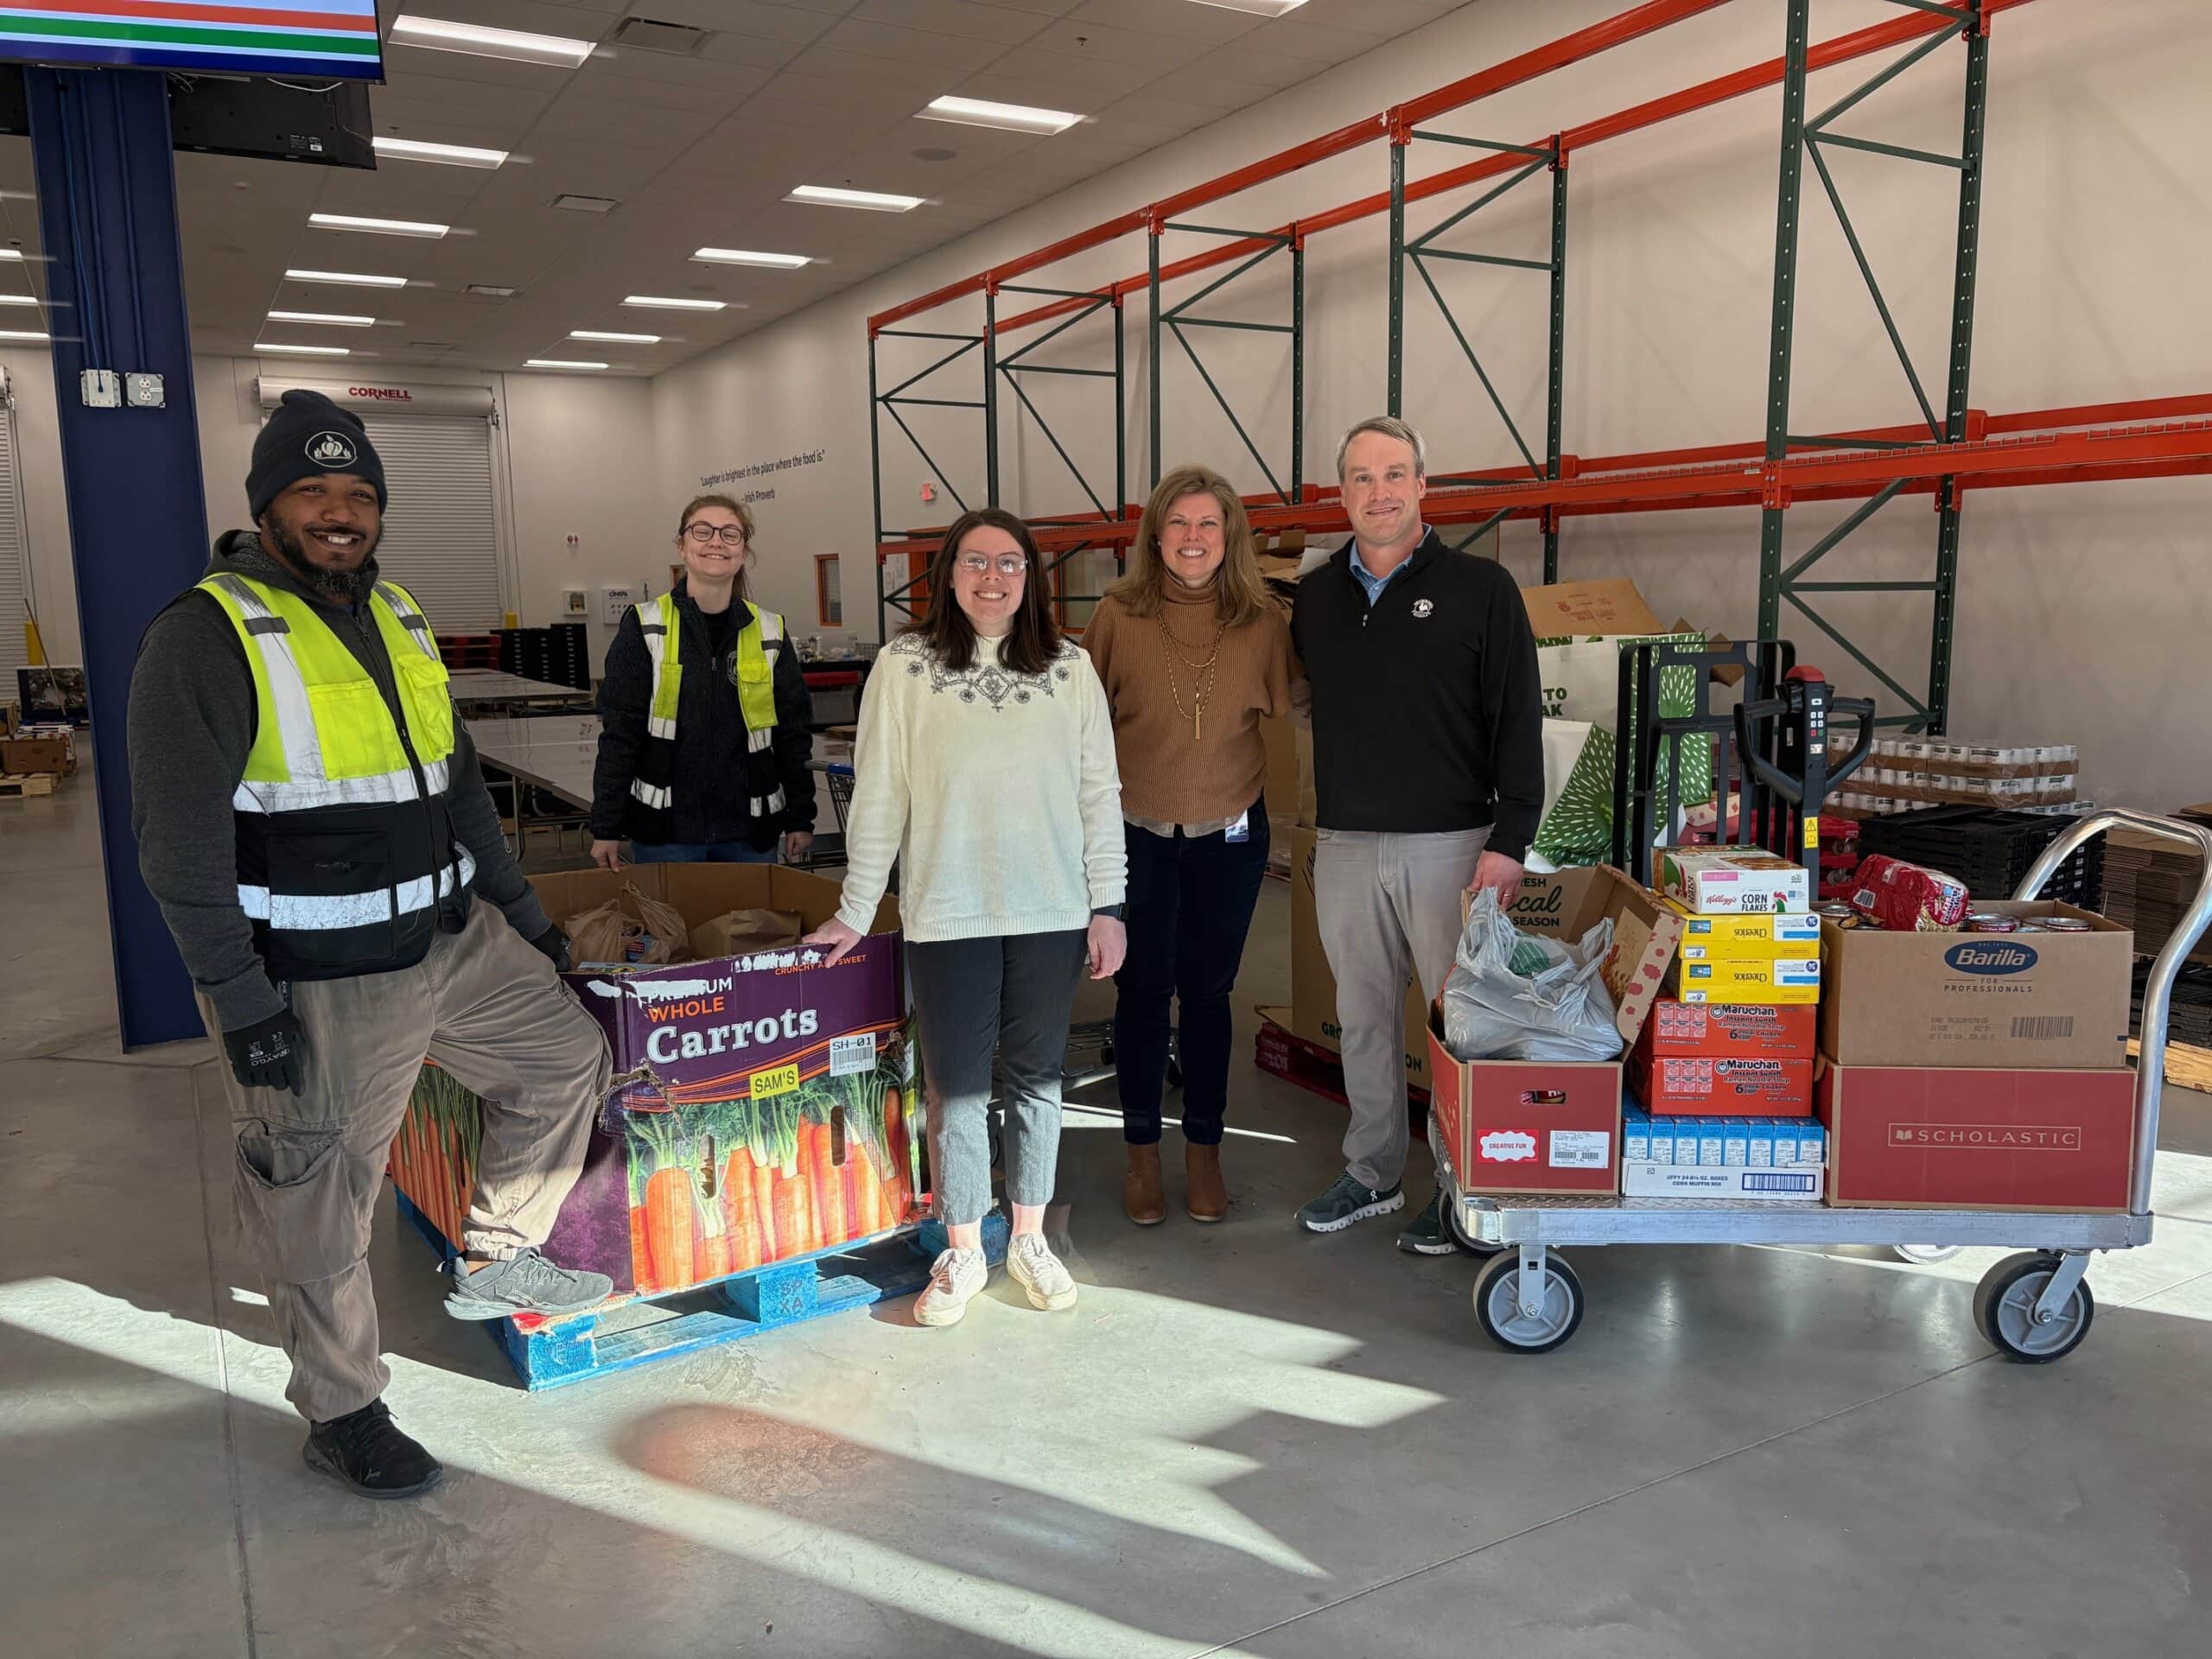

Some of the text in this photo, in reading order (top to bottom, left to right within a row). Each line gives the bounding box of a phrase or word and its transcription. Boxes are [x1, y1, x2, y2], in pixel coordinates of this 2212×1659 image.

[348, 387, 412, 400] CORNELL
[726, 467, 746, 483] brightest
[746, 466, 752, 477] in
[752, 463, 760, 475] the
[760, 461, 774, 476] place
[775, 458, 792, 470] where
[792, 454, 802, 467] the
[803, 450, 816, 465] food
[756, 487, 775, 501] Proverb
[1543, 687, 1567, 701] TO
[1521, 878, 1547, 887] ESH
[1706, 893, 1768, 906] Kellogg's CORN
[1512, 917, 1560, 927] SEASON
[1734, 928, 1768, 938] Cheerios
[1956, 949, 2026, 965] Barilla
[775, 964, 816, 976] CRUNCHY
[838, 955, 867, 966] SWEET
[1734, 973, 1768, 982] Cheerios
[1944, 984, 2033, 993] PROFESSIONALS
[648, 995, 725, 1023] WHOLE
[1721, 1005, 1776, 1016] Maruchan
[646, 1007, 819, 1065] Carrots
[1730, 1029, 1738, 1039] 6
[832, 1037, 872, 1051] SH-01
[1727, 1059, 1780, 1070] Maruchan
[754, 1070, 795, 1094] SAM'S
[1735, 1084, 1744, 1094] 6
[1918, 1130, 2075, 1145] SCHOLASTIC
